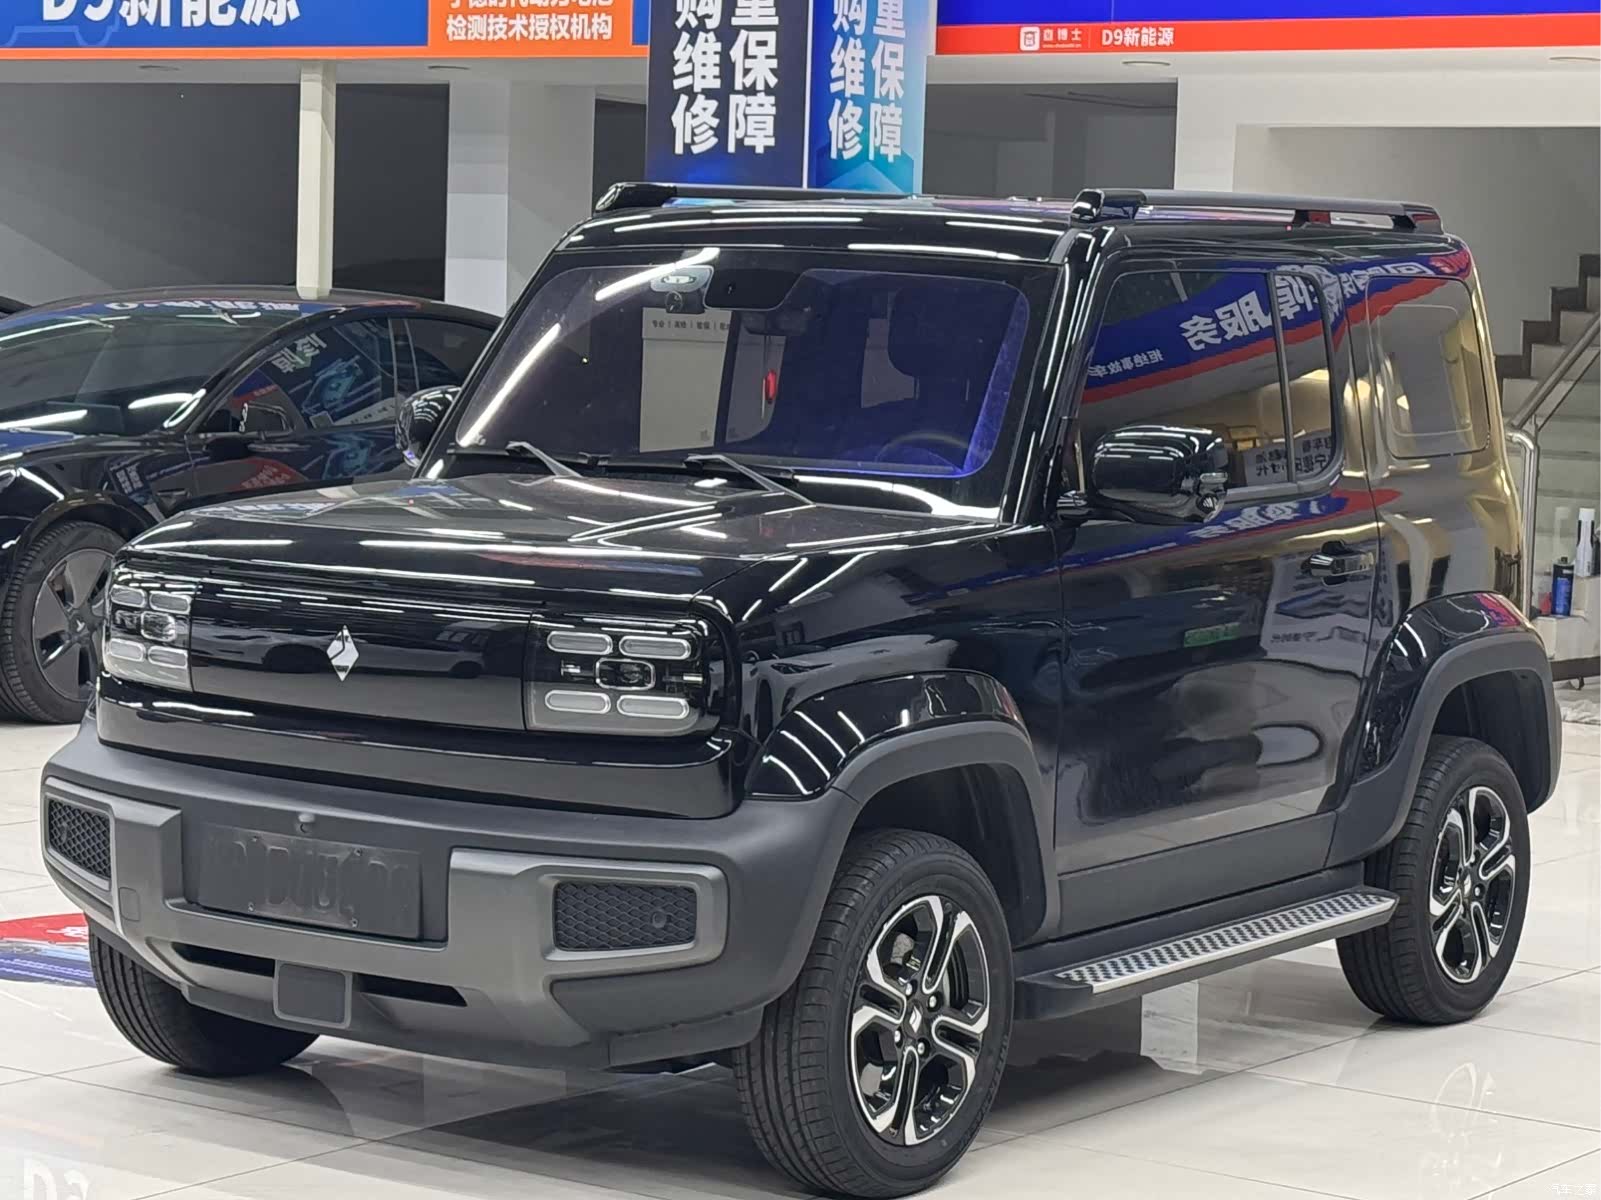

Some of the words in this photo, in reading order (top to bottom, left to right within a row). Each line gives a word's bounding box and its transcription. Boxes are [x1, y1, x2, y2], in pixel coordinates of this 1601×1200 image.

[446, 13, 613, 41] 检测技术授权机构
[1102, 27, 1174, 47] D9新能源
